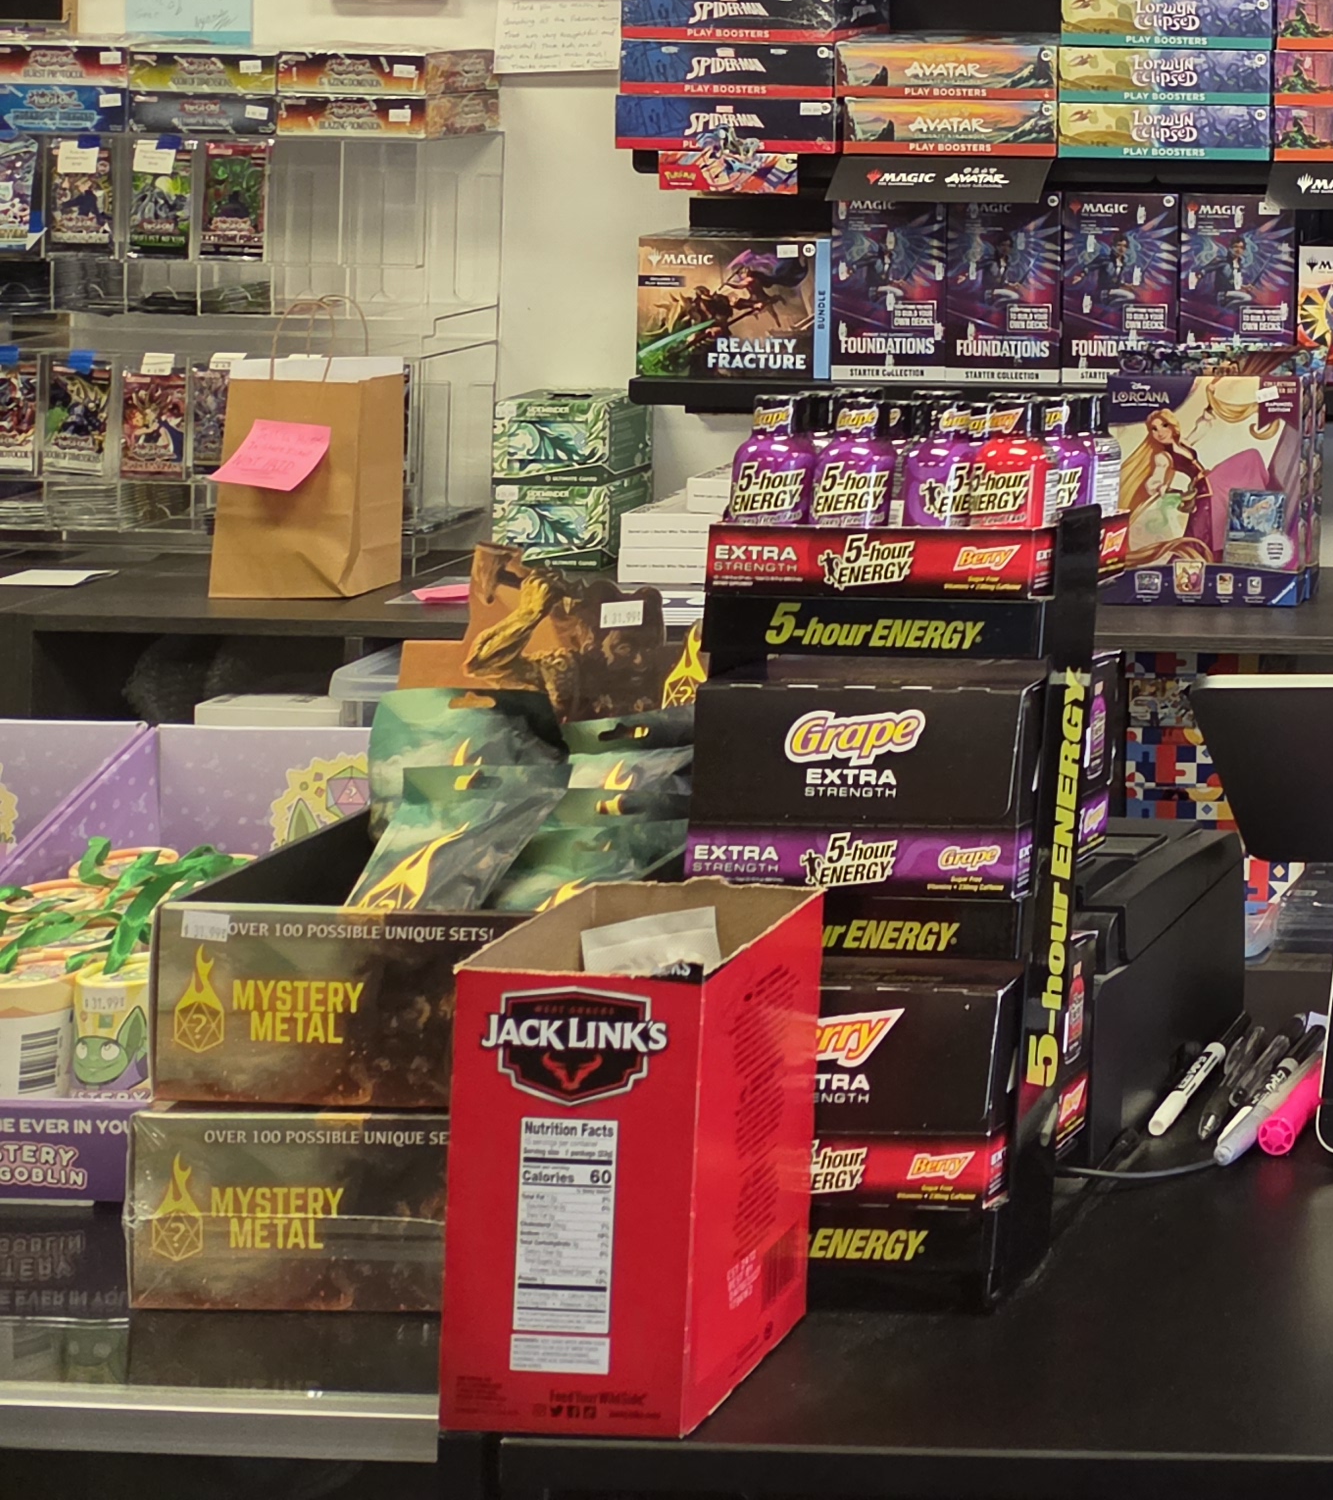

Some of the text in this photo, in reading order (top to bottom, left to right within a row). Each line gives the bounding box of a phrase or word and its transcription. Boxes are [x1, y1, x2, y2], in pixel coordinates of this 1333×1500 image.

[818, 289, 826, 330] BUNDLE
[716, 337, 797, 354] REALITY
[706, 352, 807, 370] FRACTURE
[965, 370, 1040, 380] STARTER COLLECTION
[714, 544, 797, 562] EXTRA
[844, 534, 914, 564] 5-hour
[957, 545, 1018, 570] Berry
[714, 560, 798, 574] STRENGTH
[837, 558, 912, 584] ENERGY
[765, 603, 980, 650] 5-hour ENERGY
[788, 710, 924, 764] Grape
[227, 922, 494, 943] OVER 100 POSSIBLE UNIQUE SETS!
[232, 980, 364, 1014] MYSTERY
[249, 1012, 345, 1044] METAL
[481, 1014, 668, 1052] JACK LINK'S
[524, 1121, 614, 1138] Nutrition Facts
[522, 1169, 612, 1184] Calories 60
